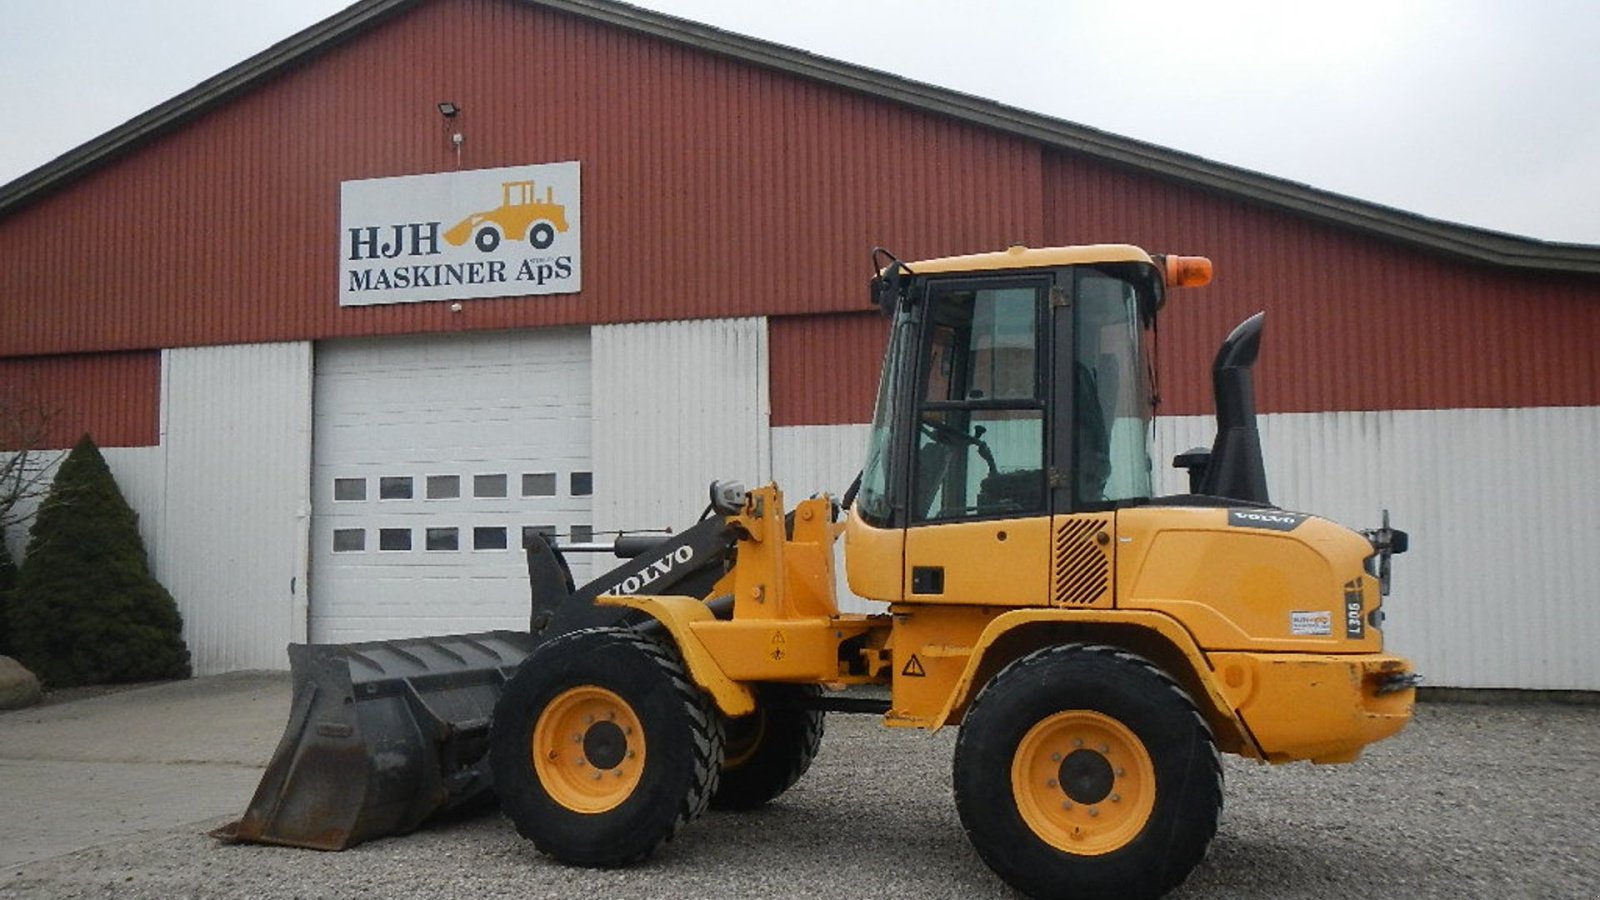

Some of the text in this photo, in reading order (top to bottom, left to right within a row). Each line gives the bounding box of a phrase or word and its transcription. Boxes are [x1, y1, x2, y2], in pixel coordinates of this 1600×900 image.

[348, 222, 442, 260] HJH
[348, 256, 572, 291] MASKINER ApS
[1234, 512, 1295, 524] VOLVO
